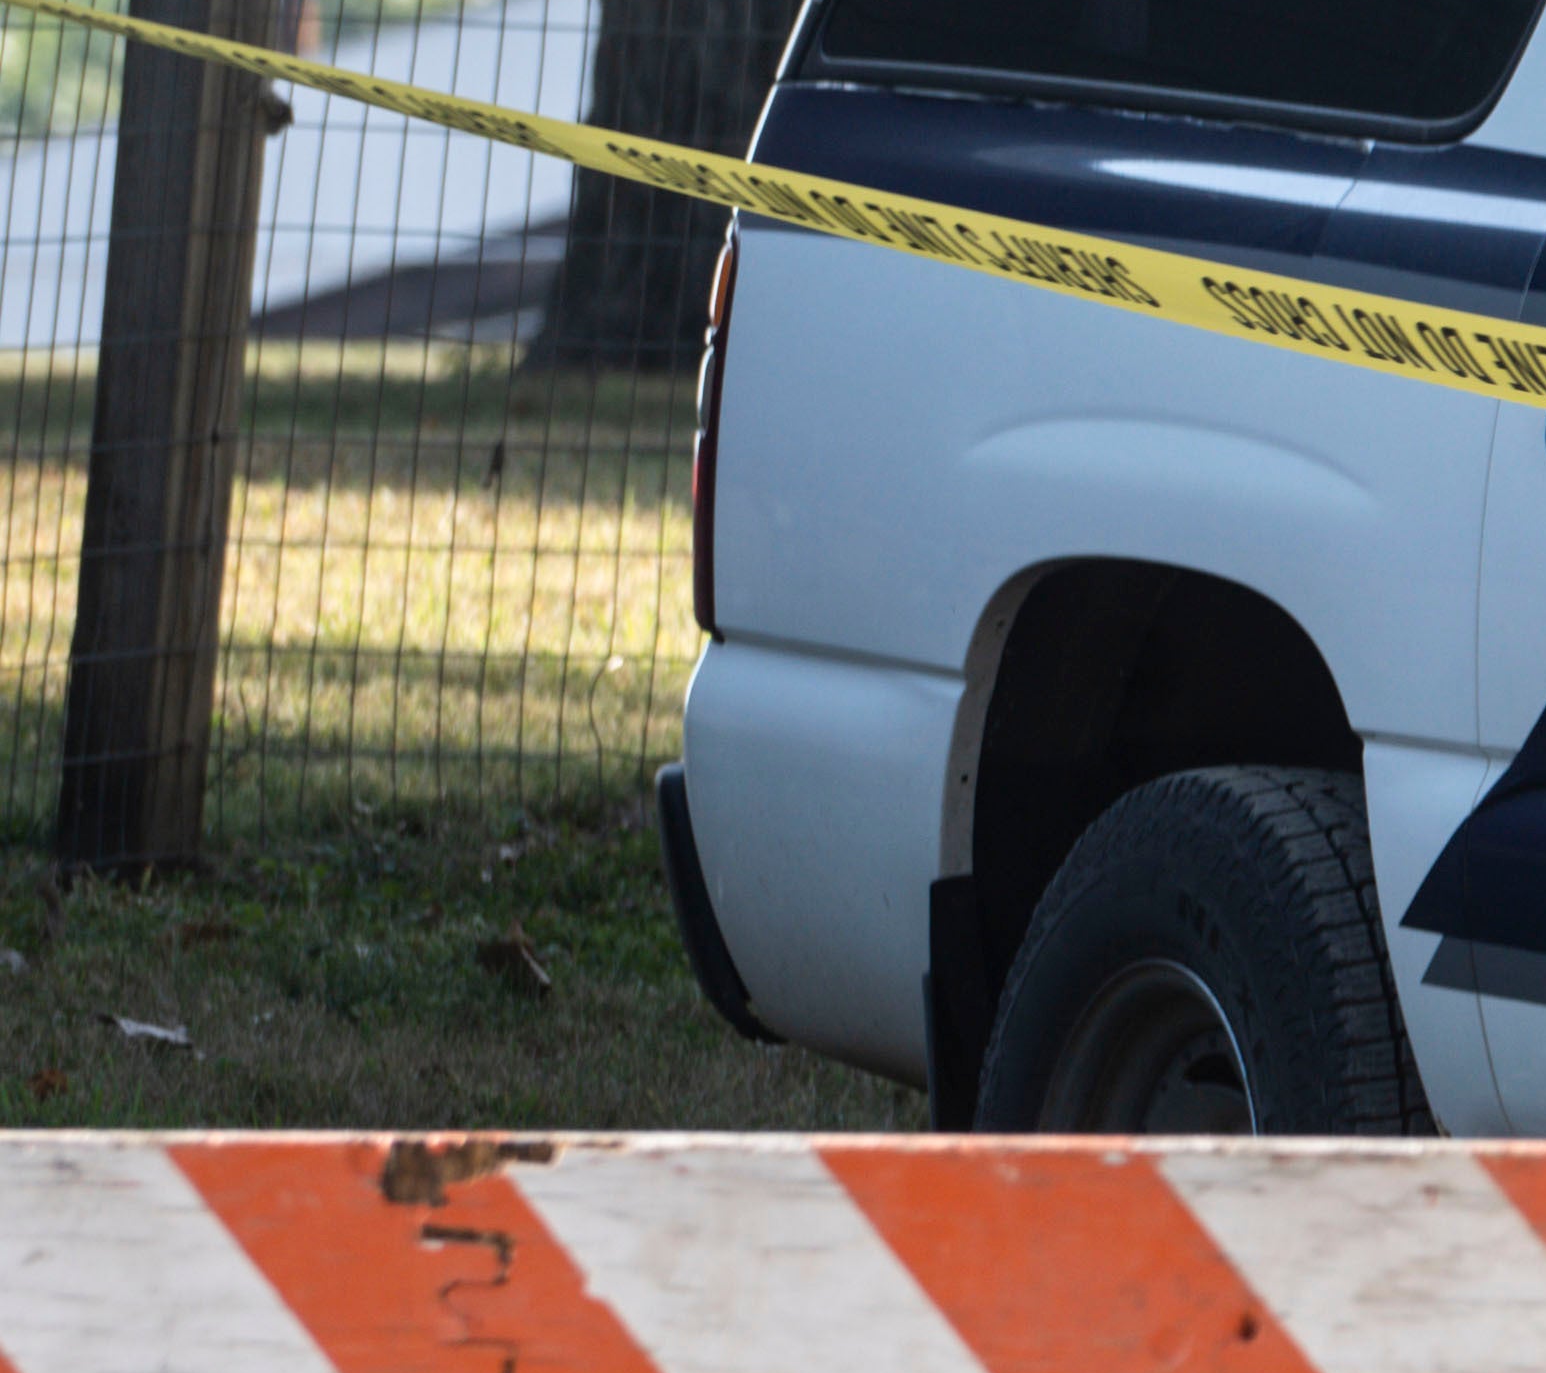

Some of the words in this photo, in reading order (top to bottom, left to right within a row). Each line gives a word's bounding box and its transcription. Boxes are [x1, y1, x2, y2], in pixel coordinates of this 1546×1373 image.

[1201, 275, 1350, 351] CROSS
[1333, 303, 1435, 371] NOT
[1415, 320, 1496, 384] DO
